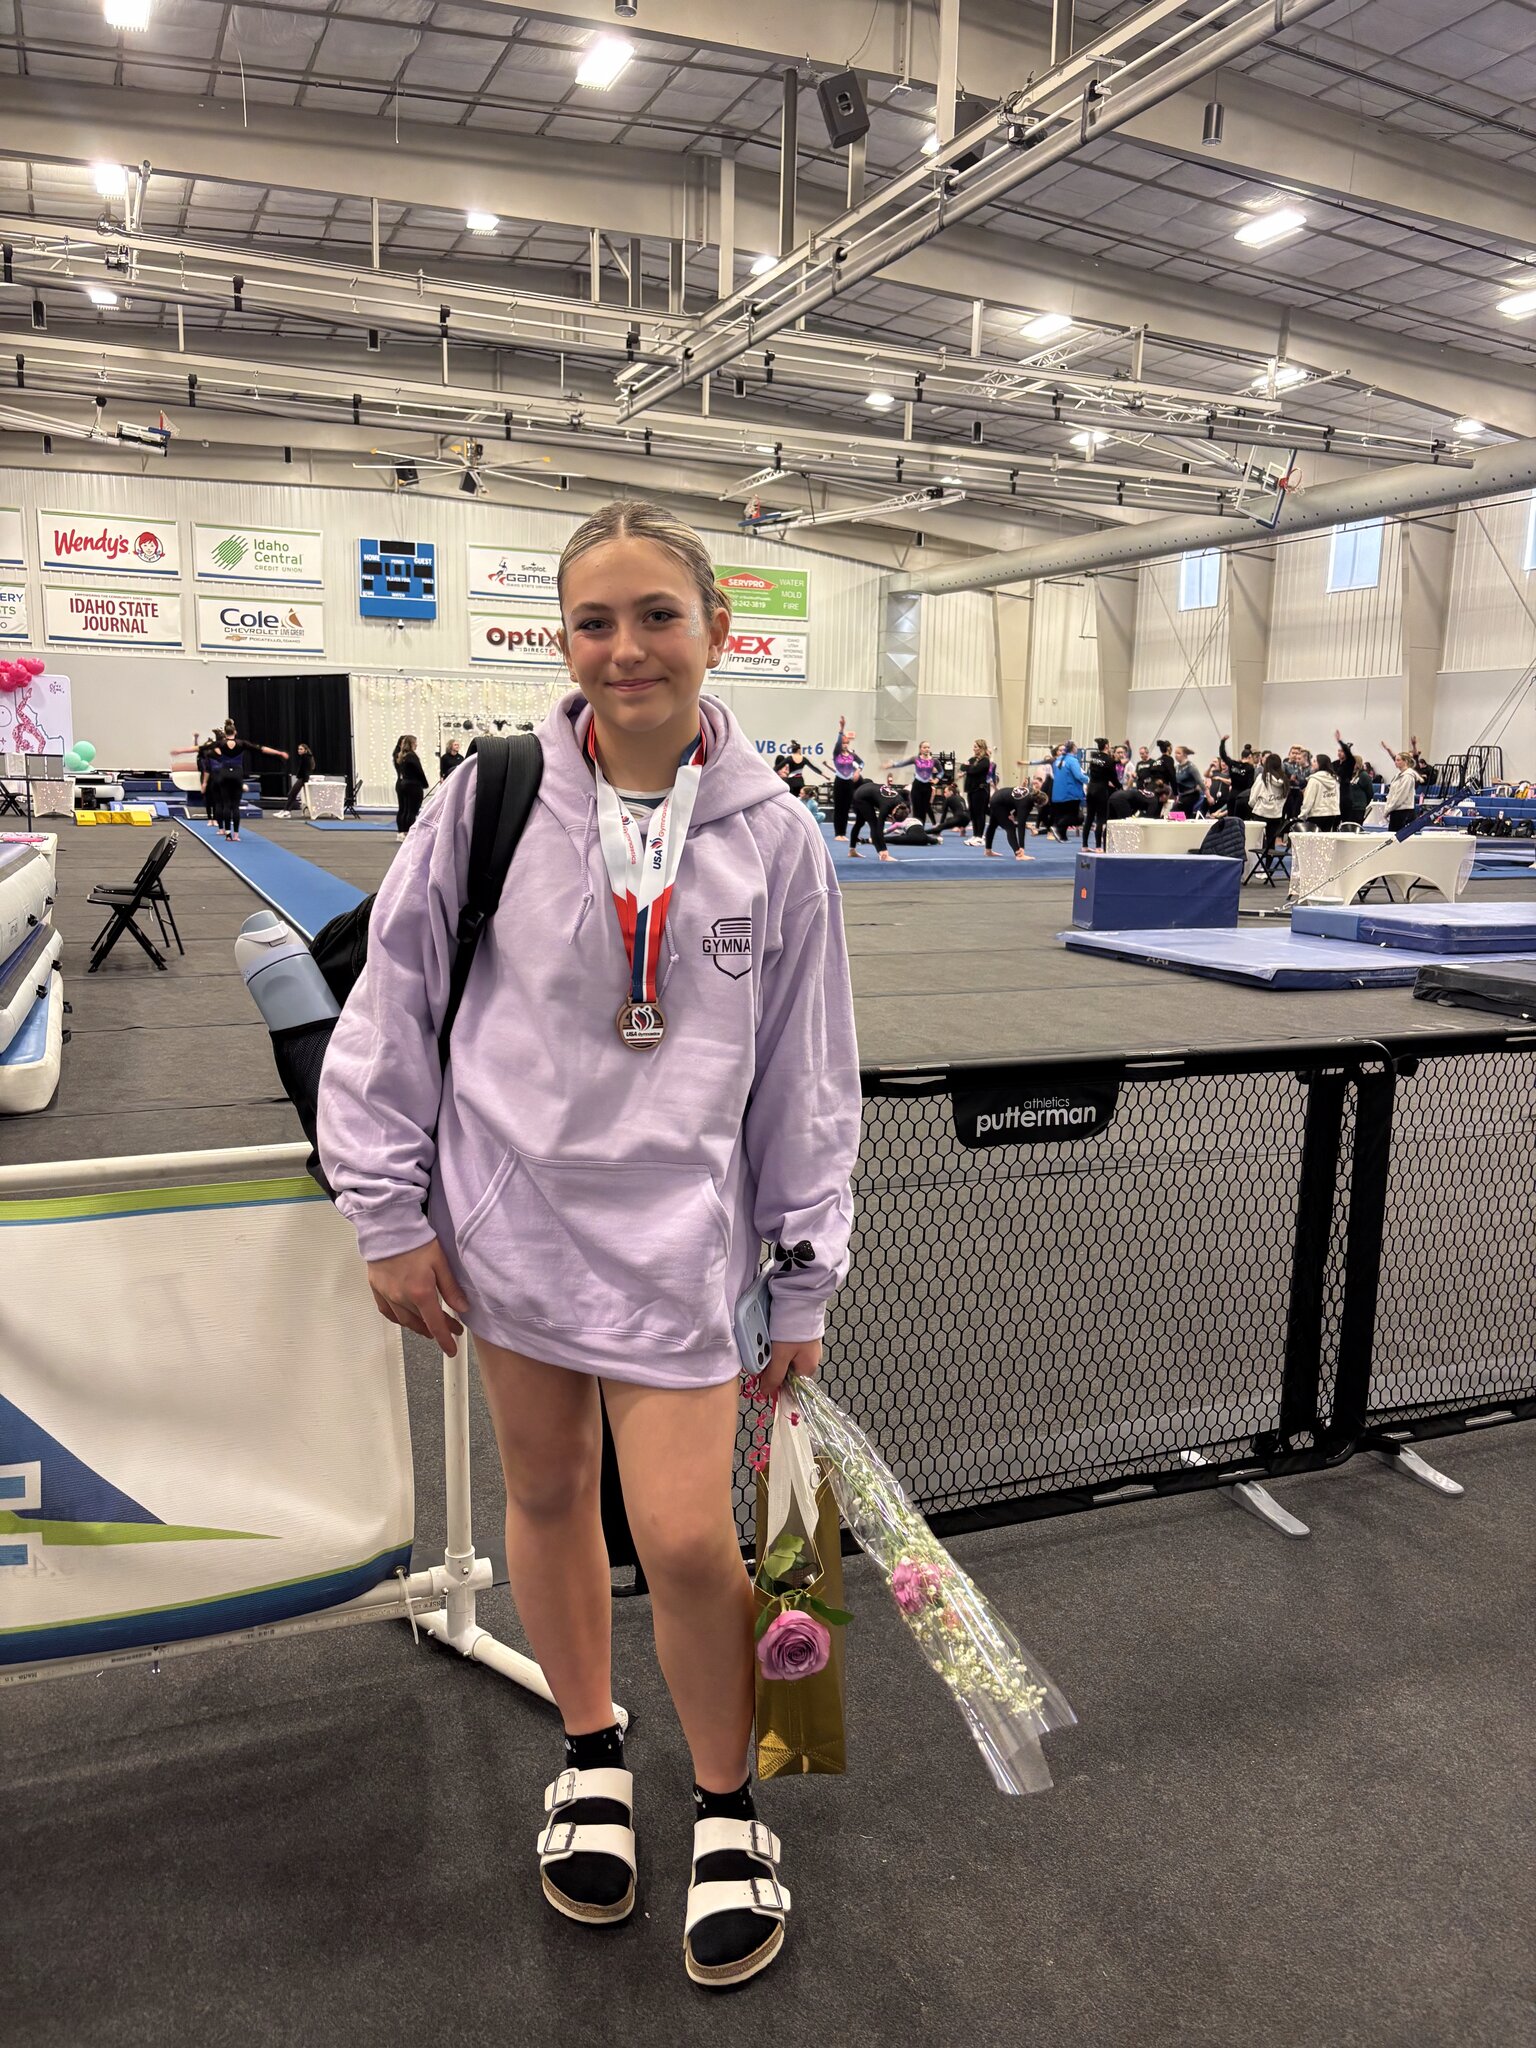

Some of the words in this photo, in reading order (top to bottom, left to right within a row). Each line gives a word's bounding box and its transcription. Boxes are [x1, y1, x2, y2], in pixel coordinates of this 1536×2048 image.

[54, 528, 129, 560] Wendy's
[254, 539, 289, 551] Idaho
[254, 551, 303, 565] Central
[521, 565, 546, 573] Simplot
[728, 579, 765, 587] SERVPRO
[780, 579, 805, 587] WATER
[781, 591, 802, 599] MOLD
[0, 605, 17, 615] TS
[70, 597, 116, 615] IDAHO
[118, 601, 159, 618] STATE
[783, 602, 799, 610] FIRE
[82, 616, 149, 634] JOURNAL
[219, 608, 279, 629] Cole
[224, 627, 279, 636] CHEVROLET
[728, 654, 781, 666] imaging
[755, 740, 776, 754] VB
[815, 742, 824, 755] 6
[653, 850, 663, 870] USA
[702, 938, 751, 953] GYMNA
[1023, 1096, 1070, 1110] athletics
[976, 1105, 1097, 1138] putterman
